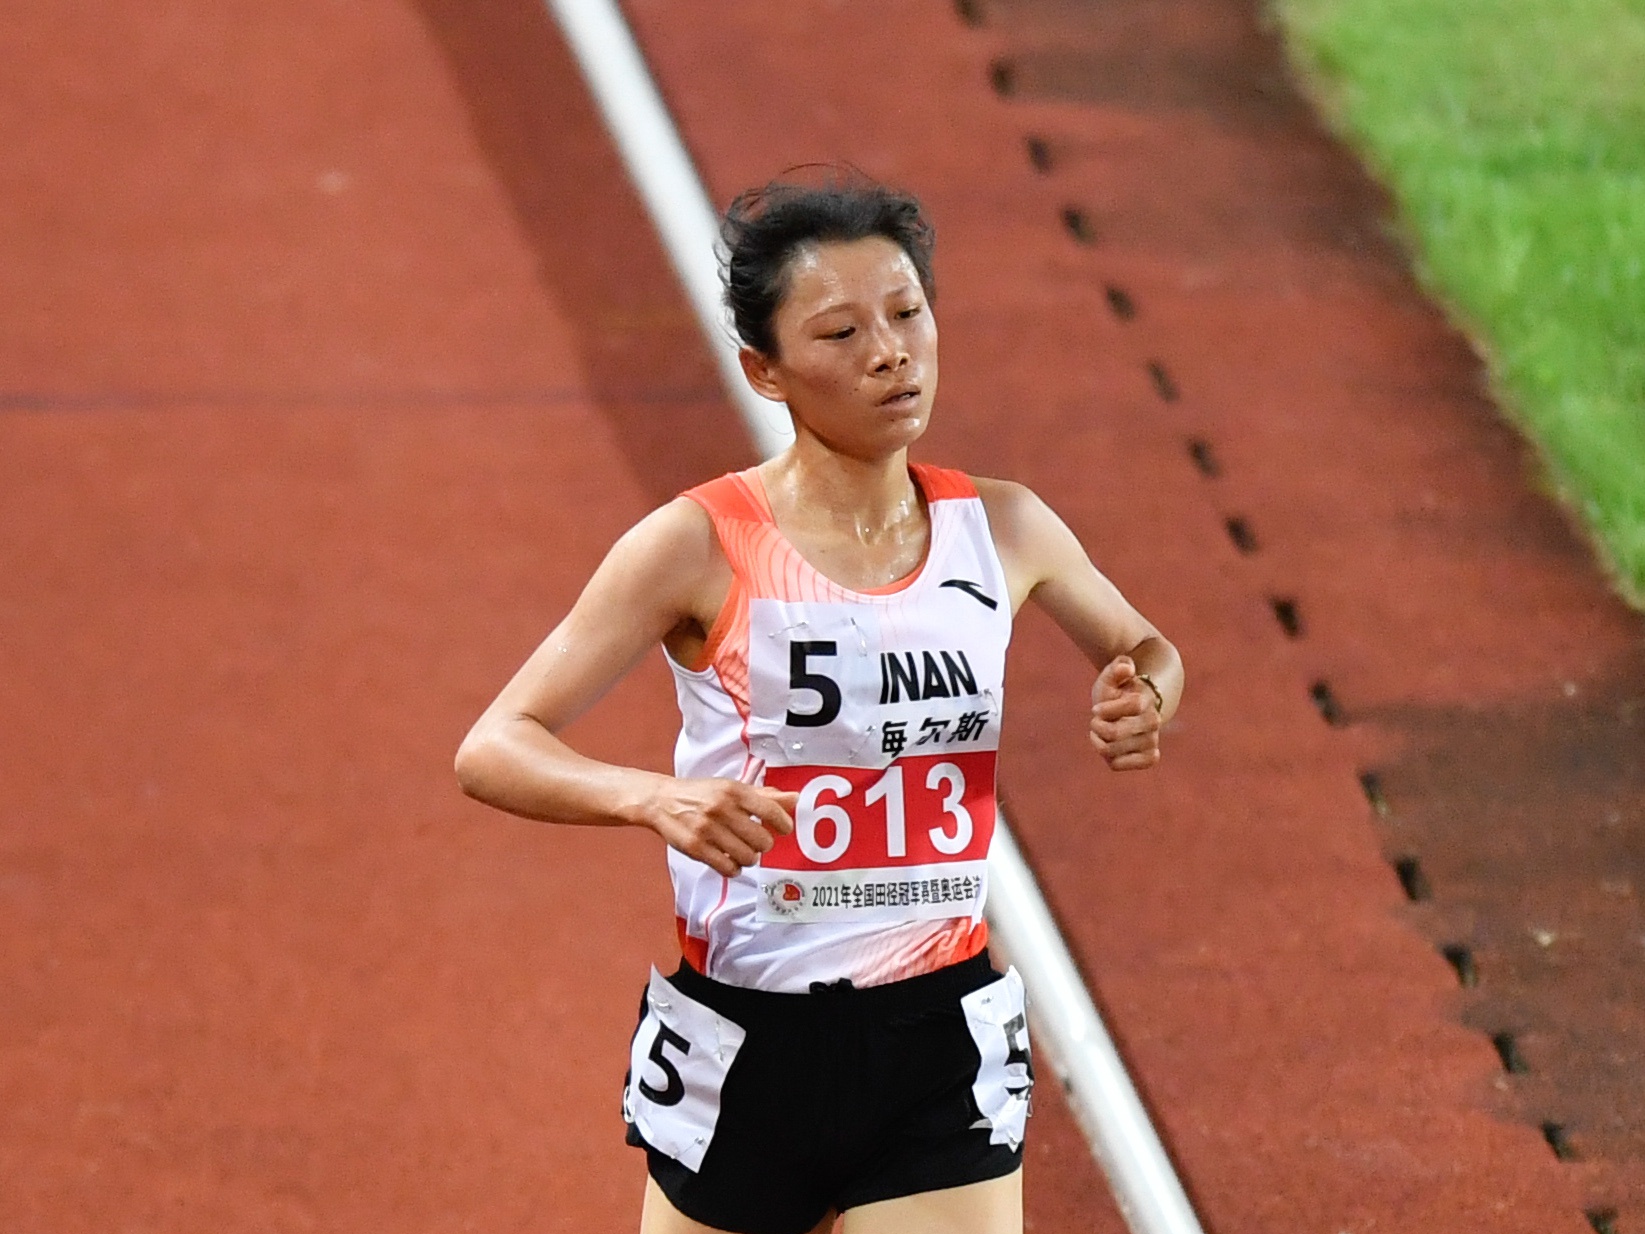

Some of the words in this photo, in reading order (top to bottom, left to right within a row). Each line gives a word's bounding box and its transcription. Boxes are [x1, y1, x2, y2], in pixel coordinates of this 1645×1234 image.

[785, 640, 842, 728] 5
[794, 762, 974, 864] 613
[638, 1019, 692, 1107] 5
